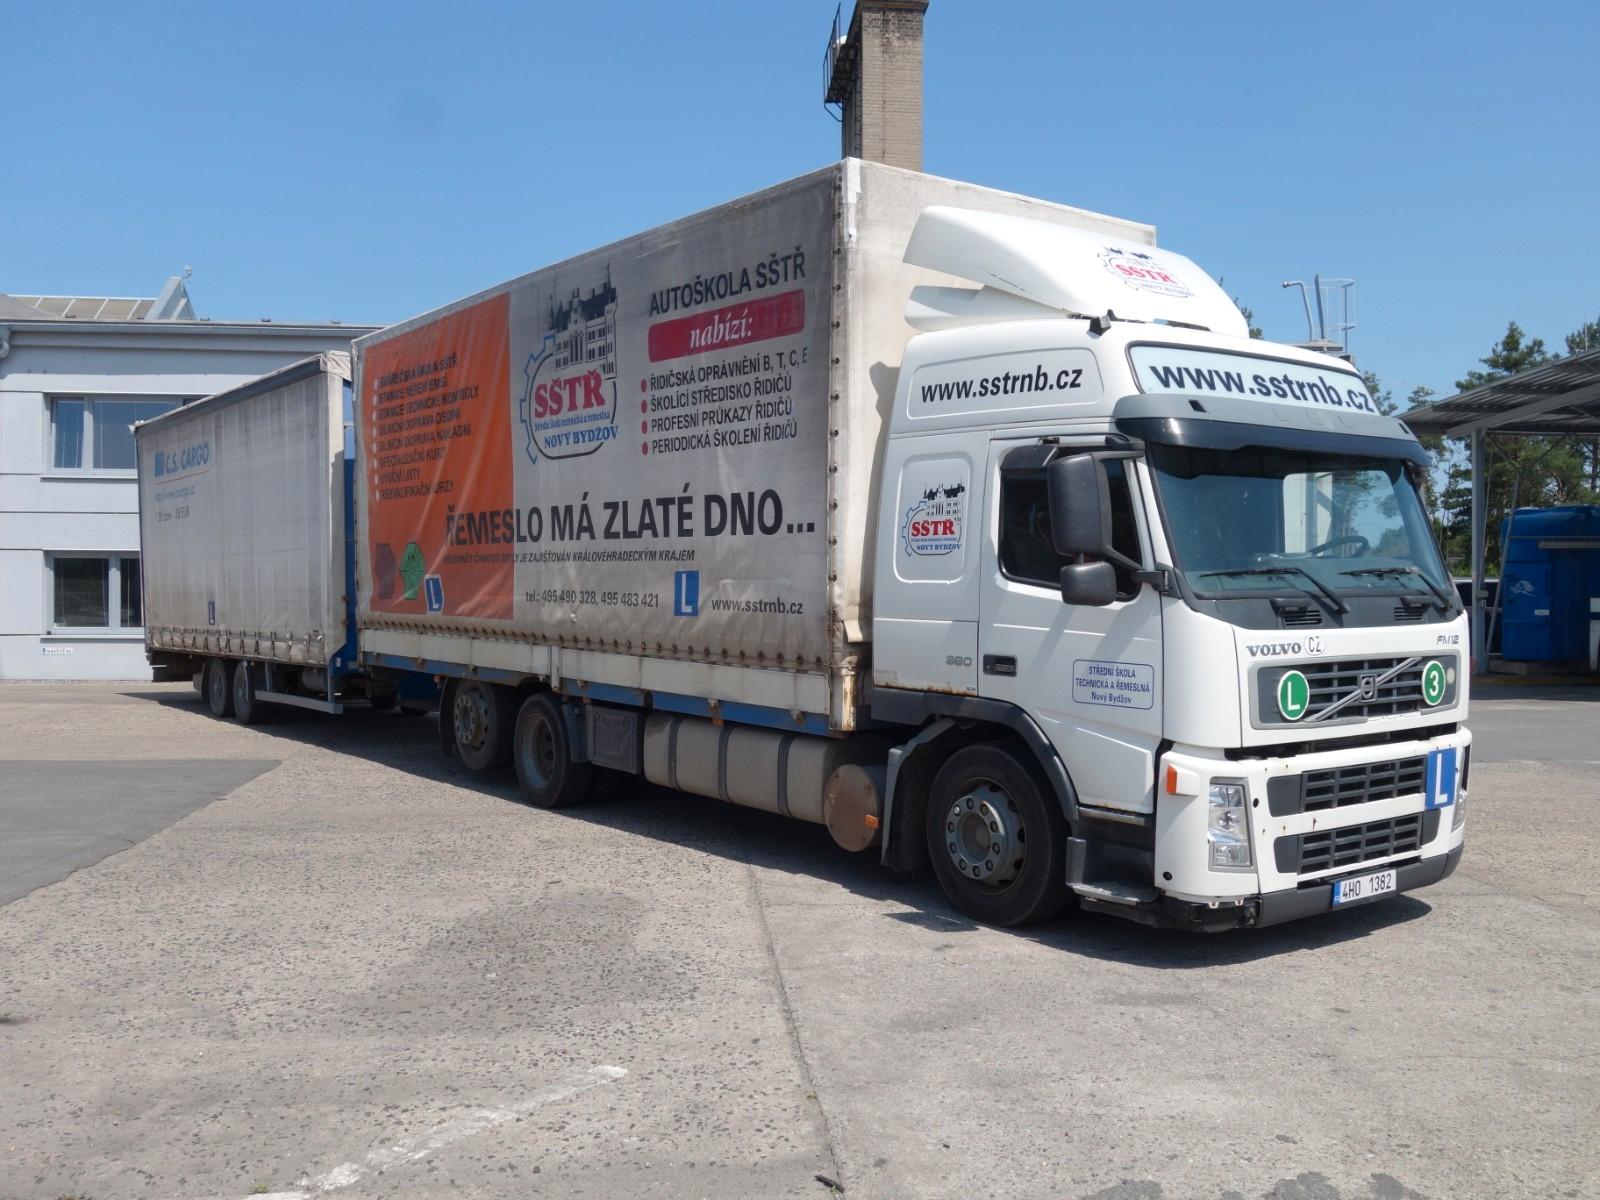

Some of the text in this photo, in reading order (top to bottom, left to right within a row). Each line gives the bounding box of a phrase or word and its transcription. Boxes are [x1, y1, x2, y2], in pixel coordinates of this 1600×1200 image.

[649, 246, 805, 316] AUTOŠKOLA SŠTŘ
[690, 308, 752, 348] nabízí:
[650, 366, 696, 391] ŘIDIČSKÁ
[699, 352, 760, 383] OPRÁVNĚNÍ
[763, 355, 773, 373] B,
[777, 352, 786, 371] T,
[789, 350, 800, 368] C,
[921, 364, 1083, 403] www.sstrnb.cz
[534, 368, 605, 418] SŠTŘ
[650, 370, 792, 412] ŠKOLÍCÍ STŘEDISKO ŘIDIČŮ
[1149, 366, 1374, 412] www.sstrnb.cz
[651, 395, 792, 432] PROFESNÍ PRŮKAZY ŘIDIČŮ
[652, 418, 797, 454] PERIODICKÁ ŠKOLENÍ ŘIDIČŮ
[181, 442, 209, 470] CARGO
[446, 482, 815, 546] ŘEMESLO MÁ ZLATÉ DNO...
[911, 518, 955, 537] SŠTŘ
[528, 549, 572, 562] ZAJIŠŤOVÁN
[572, 547, 657, 562] KRÁLOVÉHRADECKÝM
[659, 549, 695, 561] KRAJEM
[430, 580, 439, 608] L
[526, 590, 659, 608] tel.: 495 490 328, 495 483 421
[681, 573, 692, 613] L
[712, 597, 803, 614] www.sstrnb.cz
[1247, 642, 1301, 657] VOLVO
[1075, 677, 1150, 692] TECHNICKÁ A ŘEMESLNÁ
[1089, 664, 1136, 678] STŘEDNÍ ŠKOLA
[1429, 671, 1439, 696] 3
[1092, 691, 1132, 704] Nový Bydžov
[1288, 681, 1300, 710] L
[1434, 753, 1448, 804] L
[1369, 873, 1392, 893] 1382
